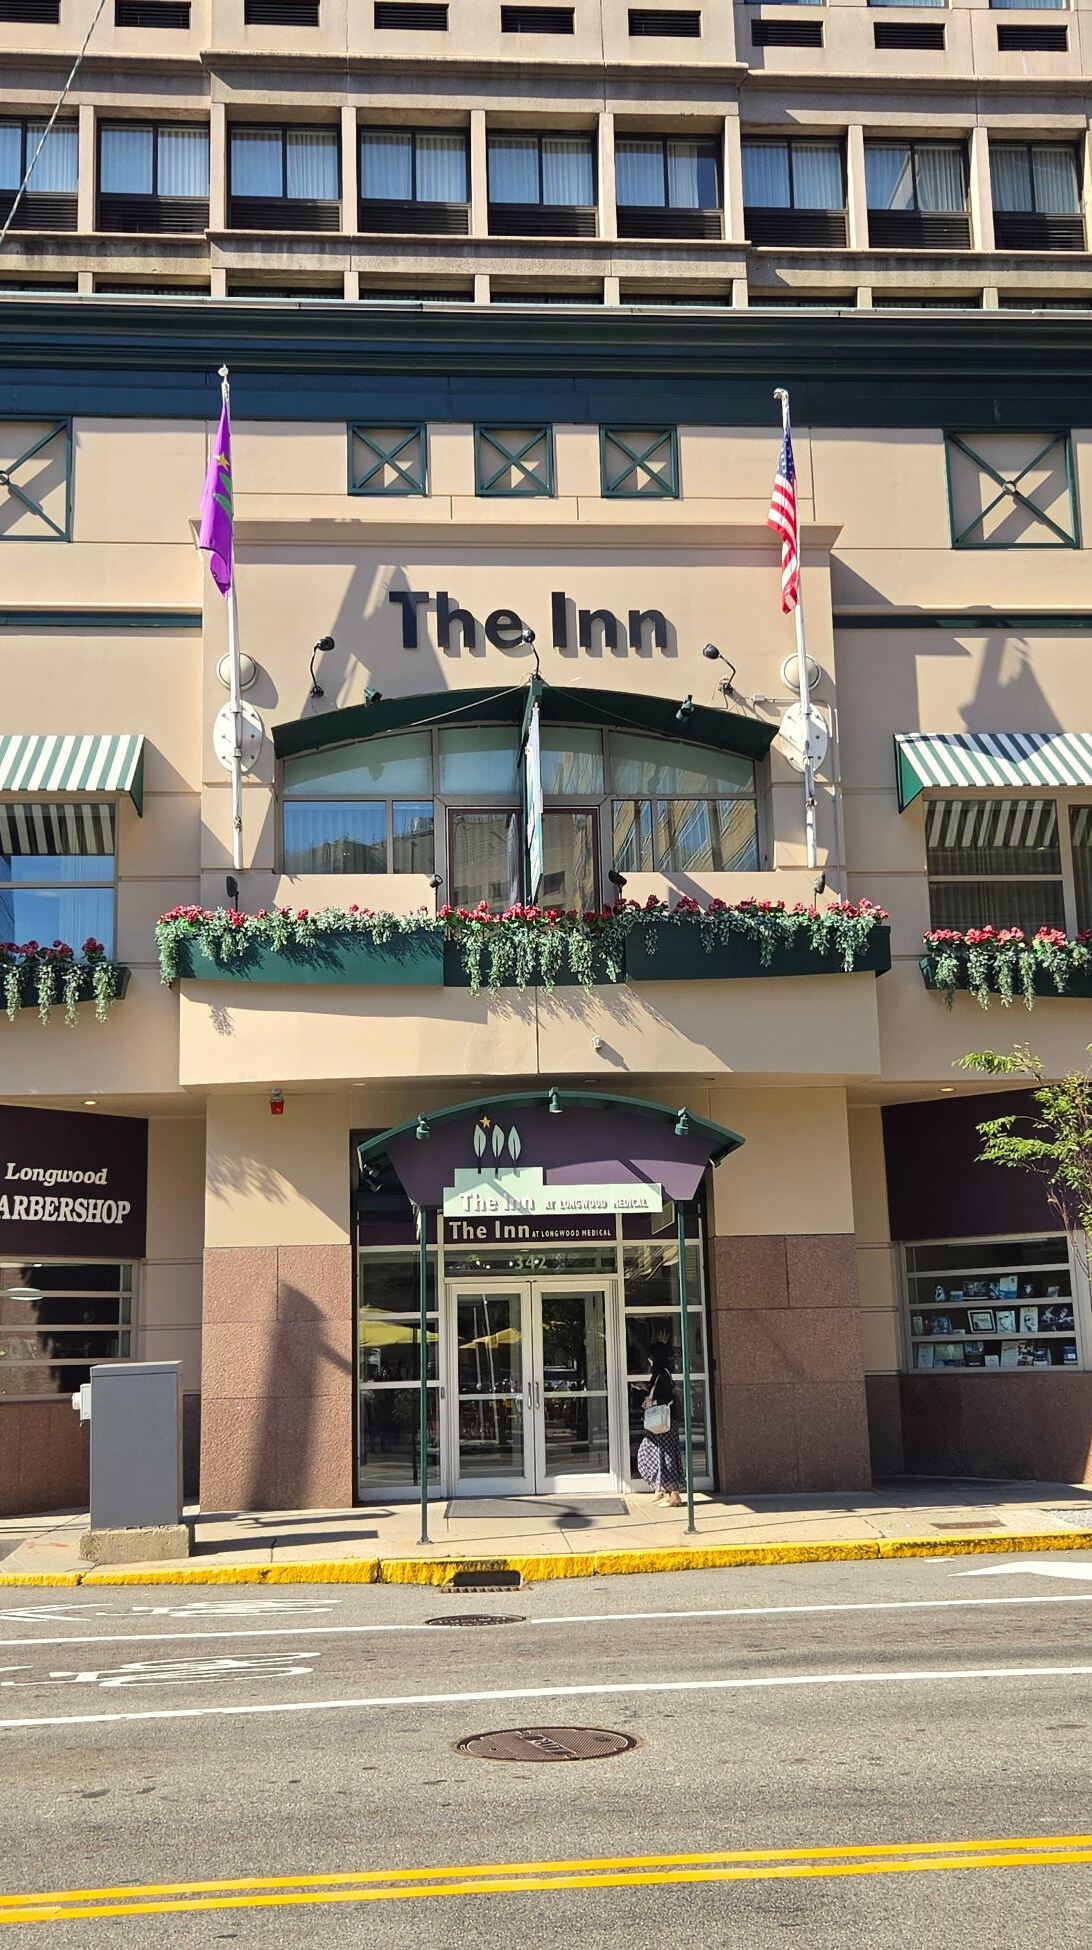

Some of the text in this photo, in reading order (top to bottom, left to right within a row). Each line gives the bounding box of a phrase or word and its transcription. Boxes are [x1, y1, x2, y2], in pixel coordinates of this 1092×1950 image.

[389, 591, 668, 649] The Inn
[4, 1162, 108, 1187] Longwood
[459, 1191, 649, 1212] The Inn AT LONGWOOD MEDICAL
[449, 1220, 612, 1239] The Inn AT LONGWOOD MEDICAL
[514, 1254, 547, 1269] 342
